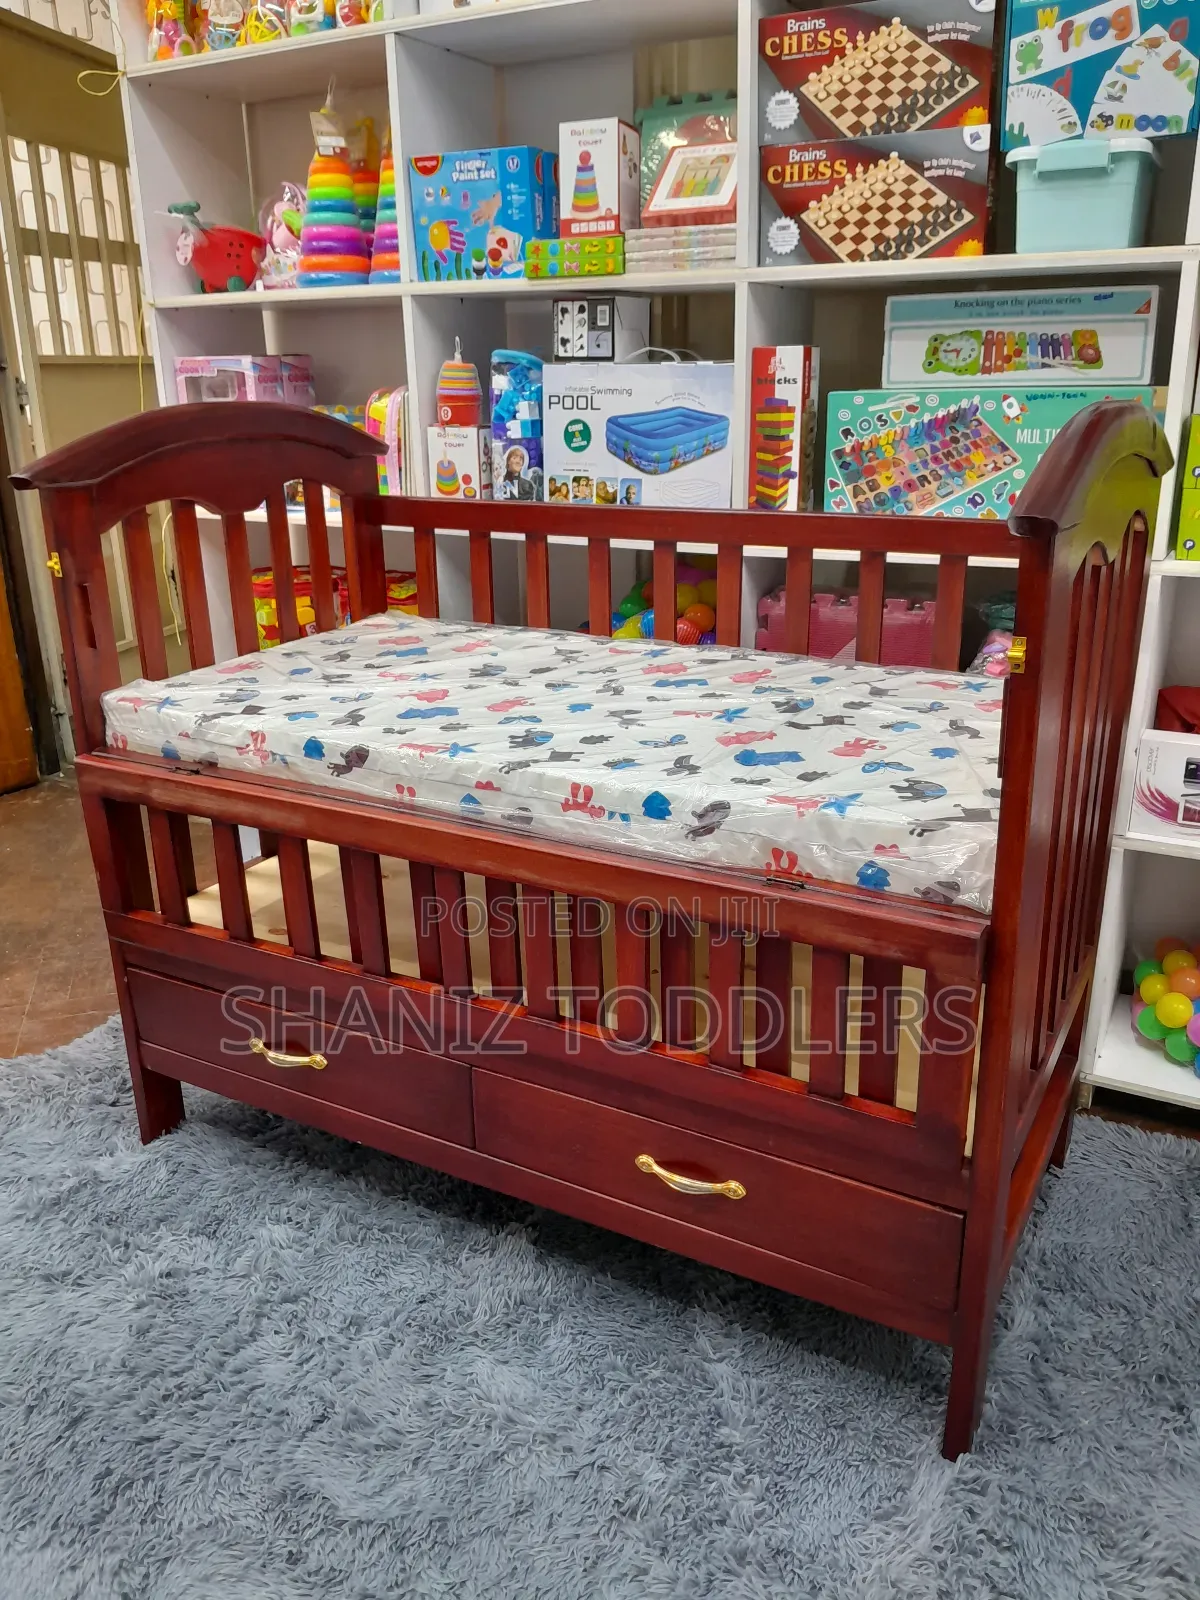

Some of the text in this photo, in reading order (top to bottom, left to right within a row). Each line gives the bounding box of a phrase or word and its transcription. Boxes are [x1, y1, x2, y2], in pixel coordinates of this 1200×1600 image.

[787, 16, 826, 33] Brains
[1057, 5, 1134, 53] frog
[764, 27, 849, 57] CHESS
[788, 147, 827, 163] Brains
[451, 168, 496, 184] Paint Set
[766, 158, 848, 185] CHESS
[953, 297, 995, 309] Knocking
[997, 299, 1009, 307] on
[1010, 297, 1025, 307] the
[1027, 297, 1054, 308] piano
[1055, 295, 1082, 305] series
[590, 385, 633, 397] Swimming
[548, 394, 601, 411] POOL
[1016, 428, 1061, 444] MULTI
